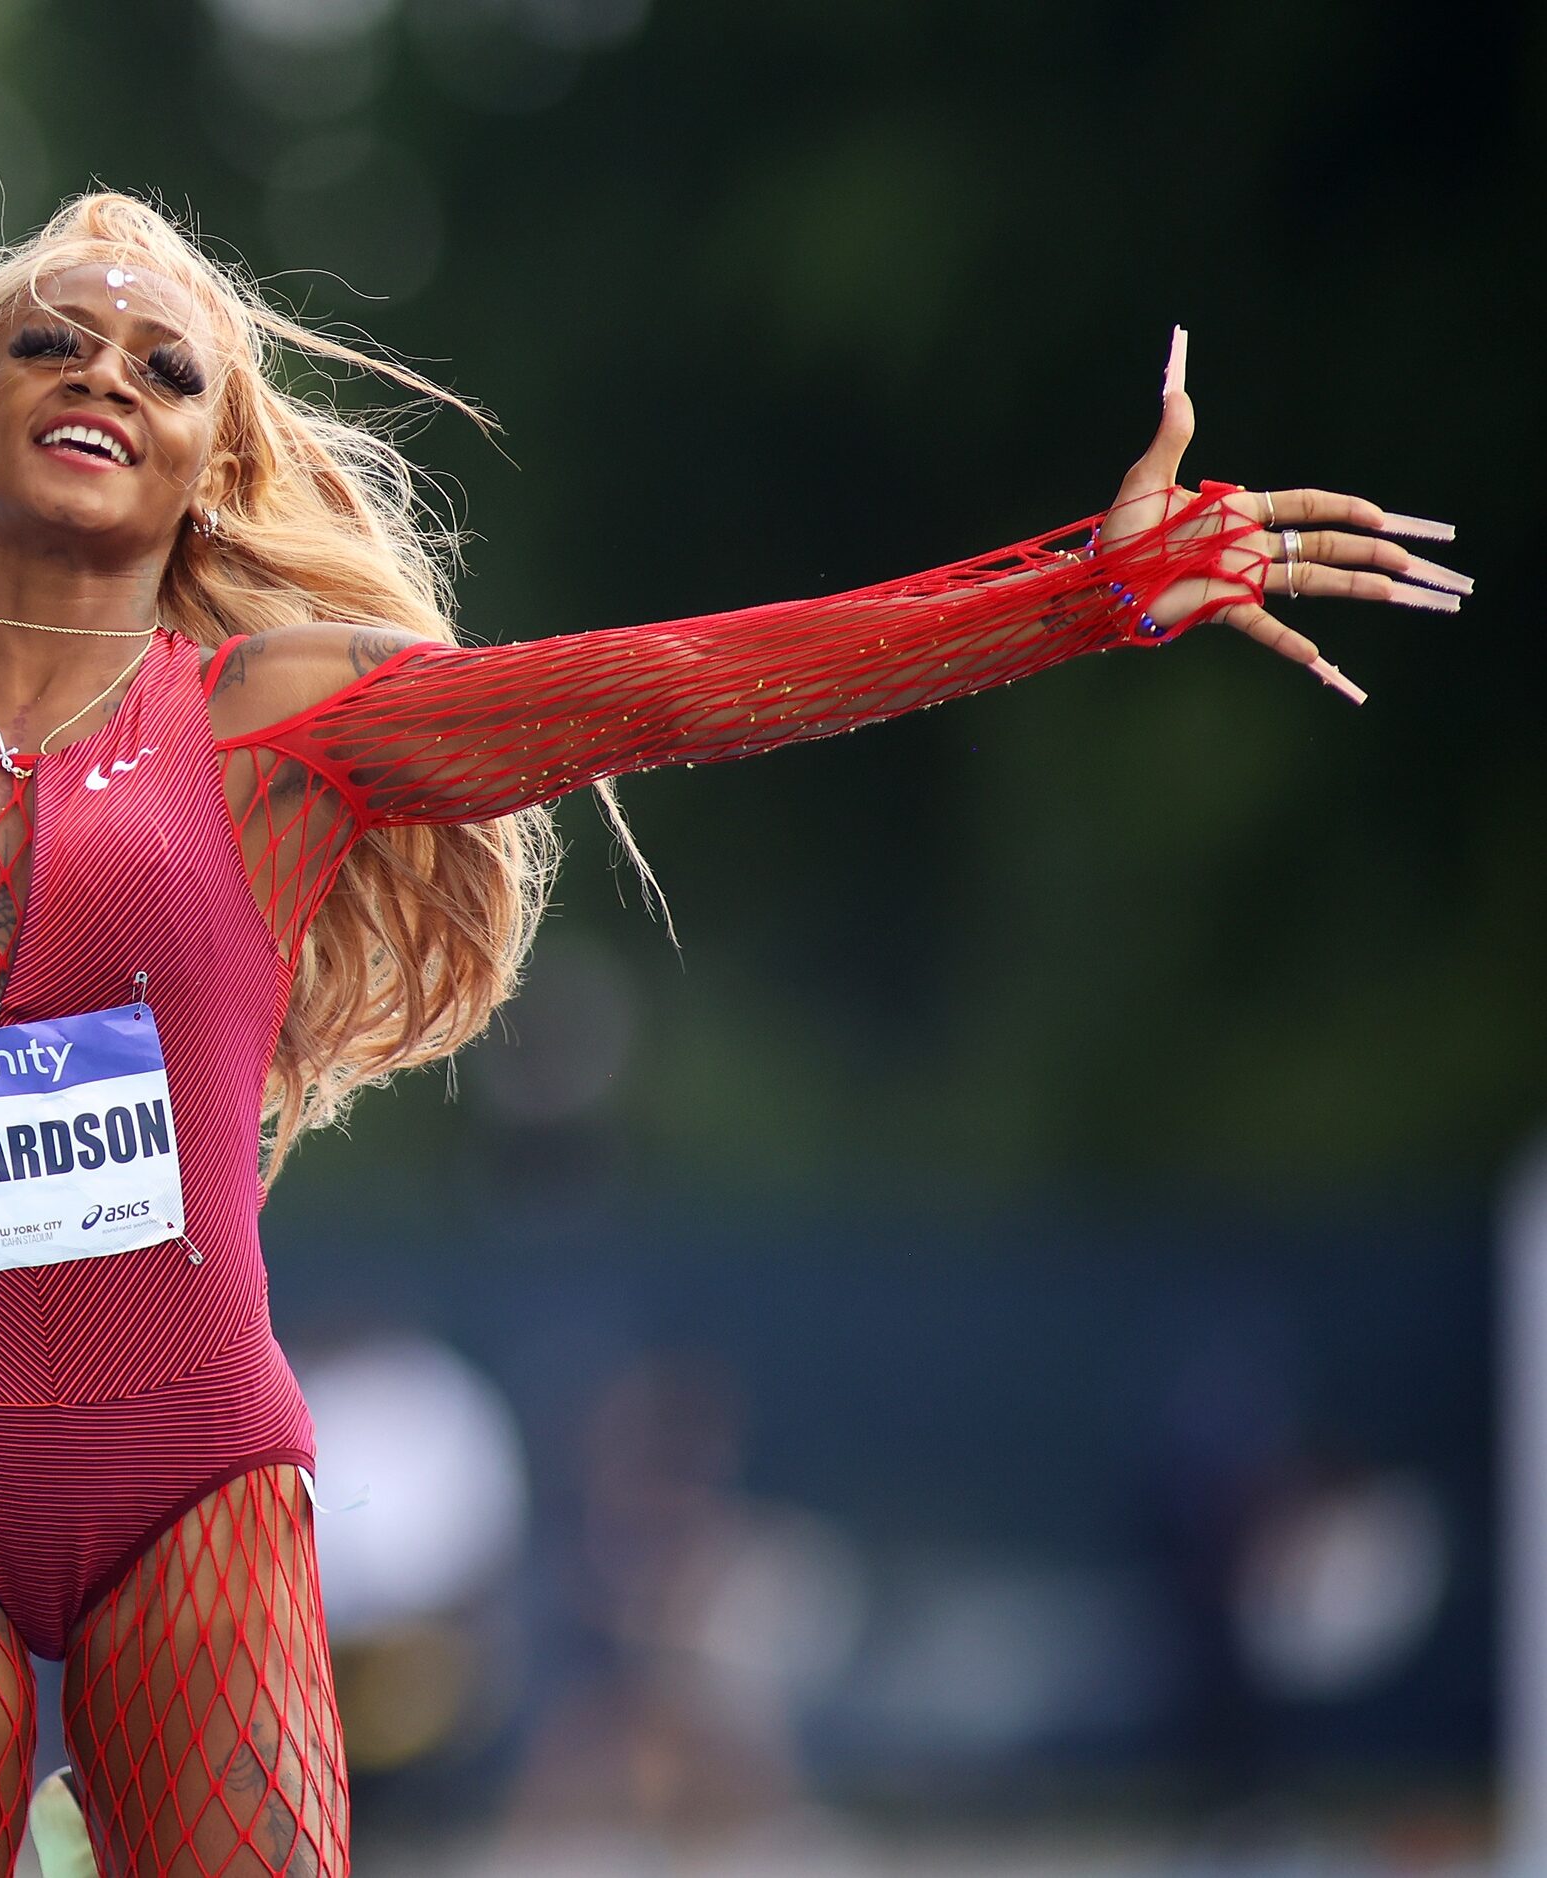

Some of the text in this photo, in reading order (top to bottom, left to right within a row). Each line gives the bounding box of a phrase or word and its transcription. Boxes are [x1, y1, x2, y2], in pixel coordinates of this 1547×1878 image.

[13, 1224, 40, 1235] YORK
[43, 1220, 62, 1230] CITY
[23, 1231, 54, 1245] STADIUM
